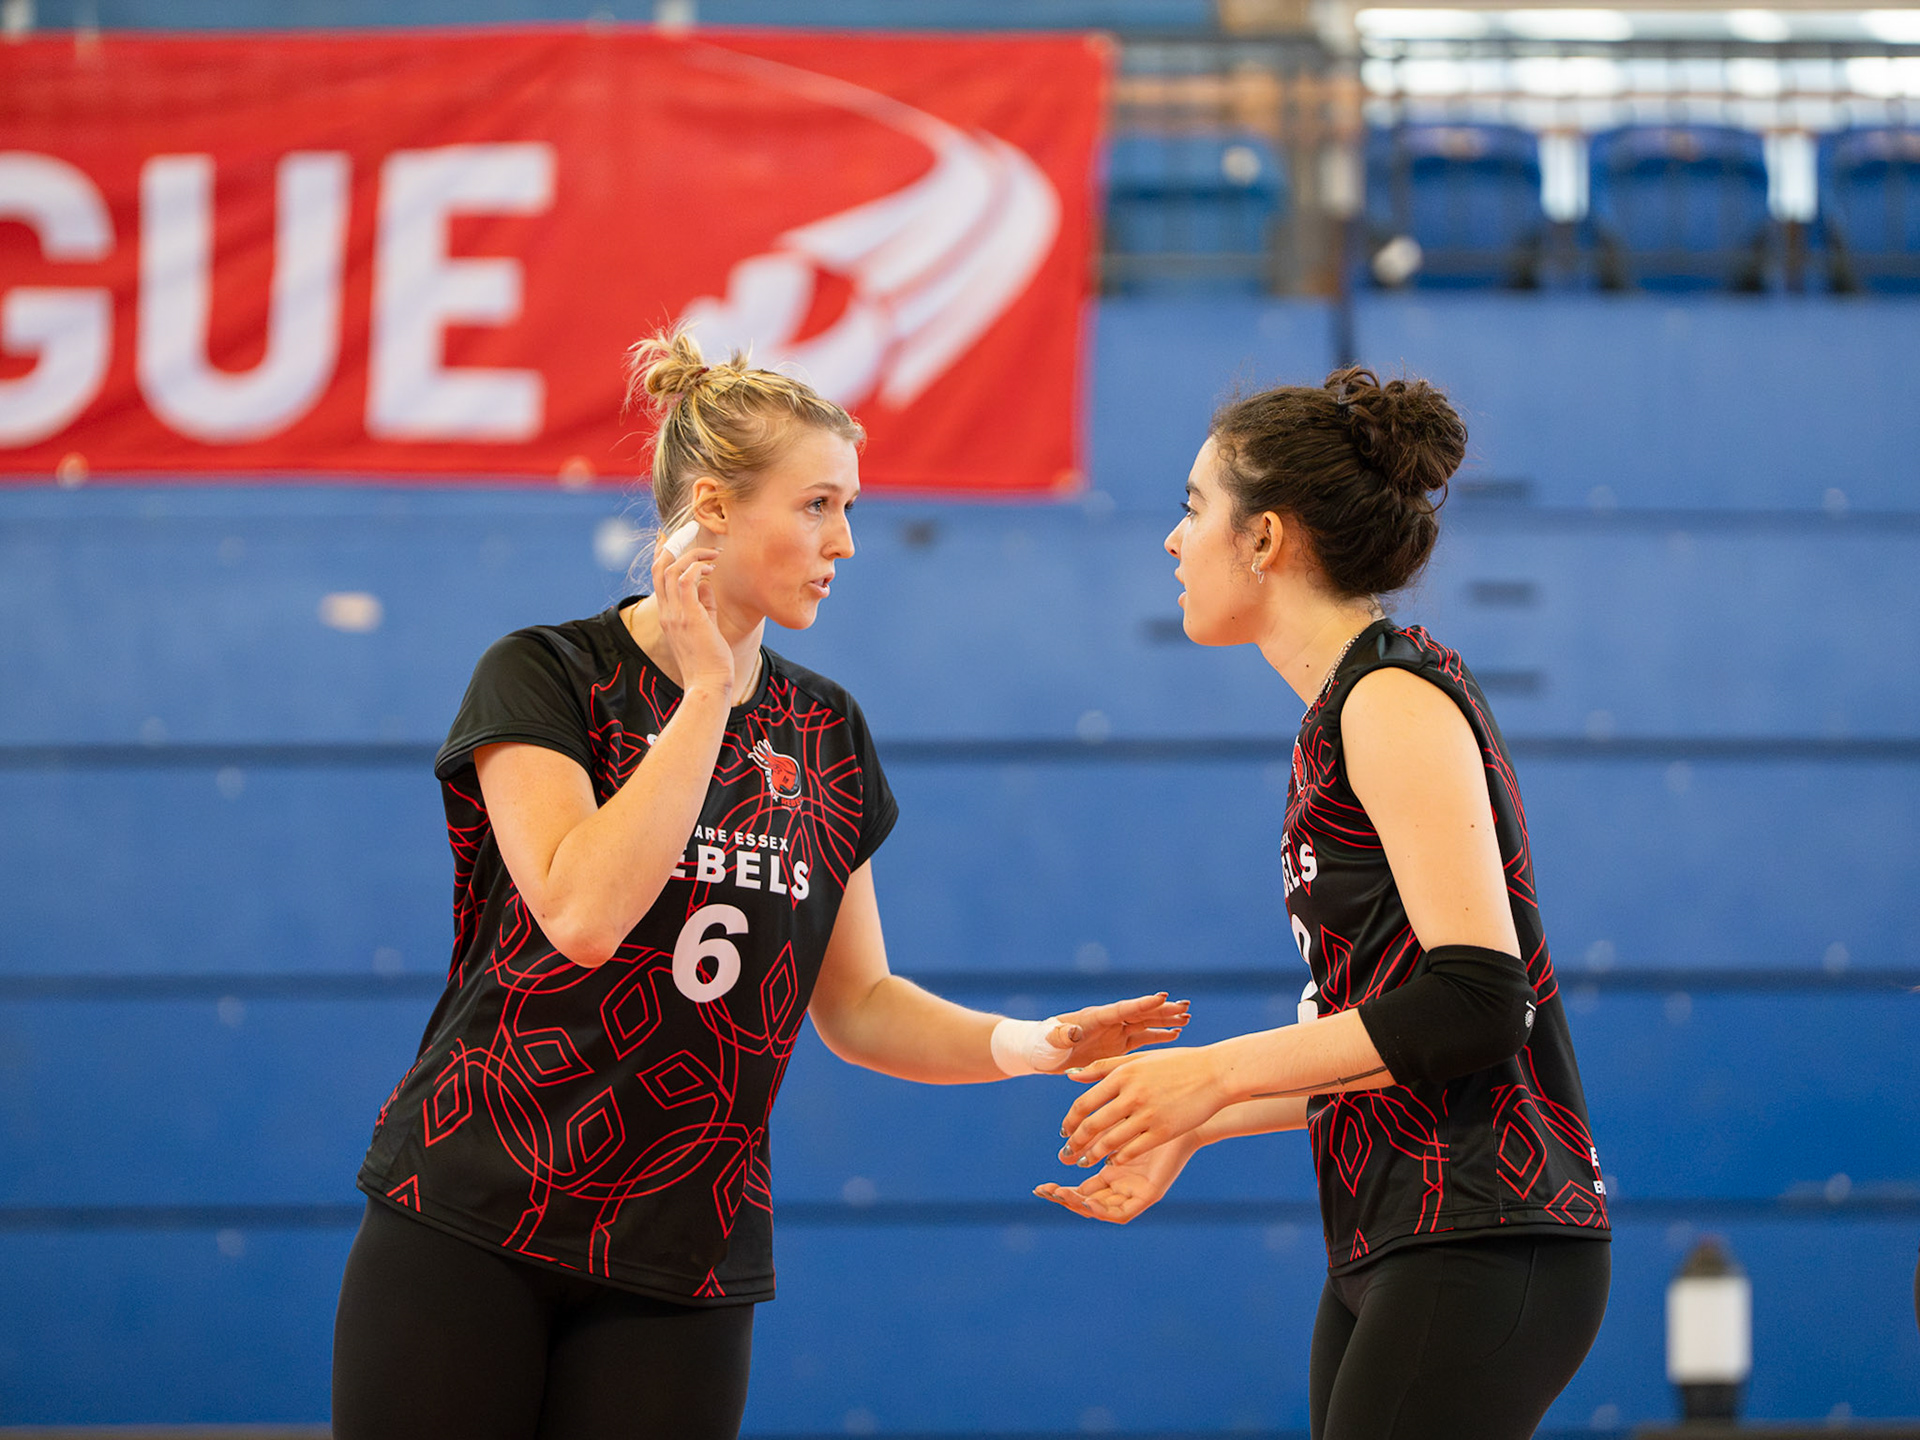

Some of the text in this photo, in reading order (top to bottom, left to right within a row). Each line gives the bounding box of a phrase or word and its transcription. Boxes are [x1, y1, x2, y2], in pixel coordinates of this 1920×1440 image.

[0, 143, 556, 448] GUE
[694, 825, 789, 852] ARE ESSEX
[672, 903, 749, 1003] 6
